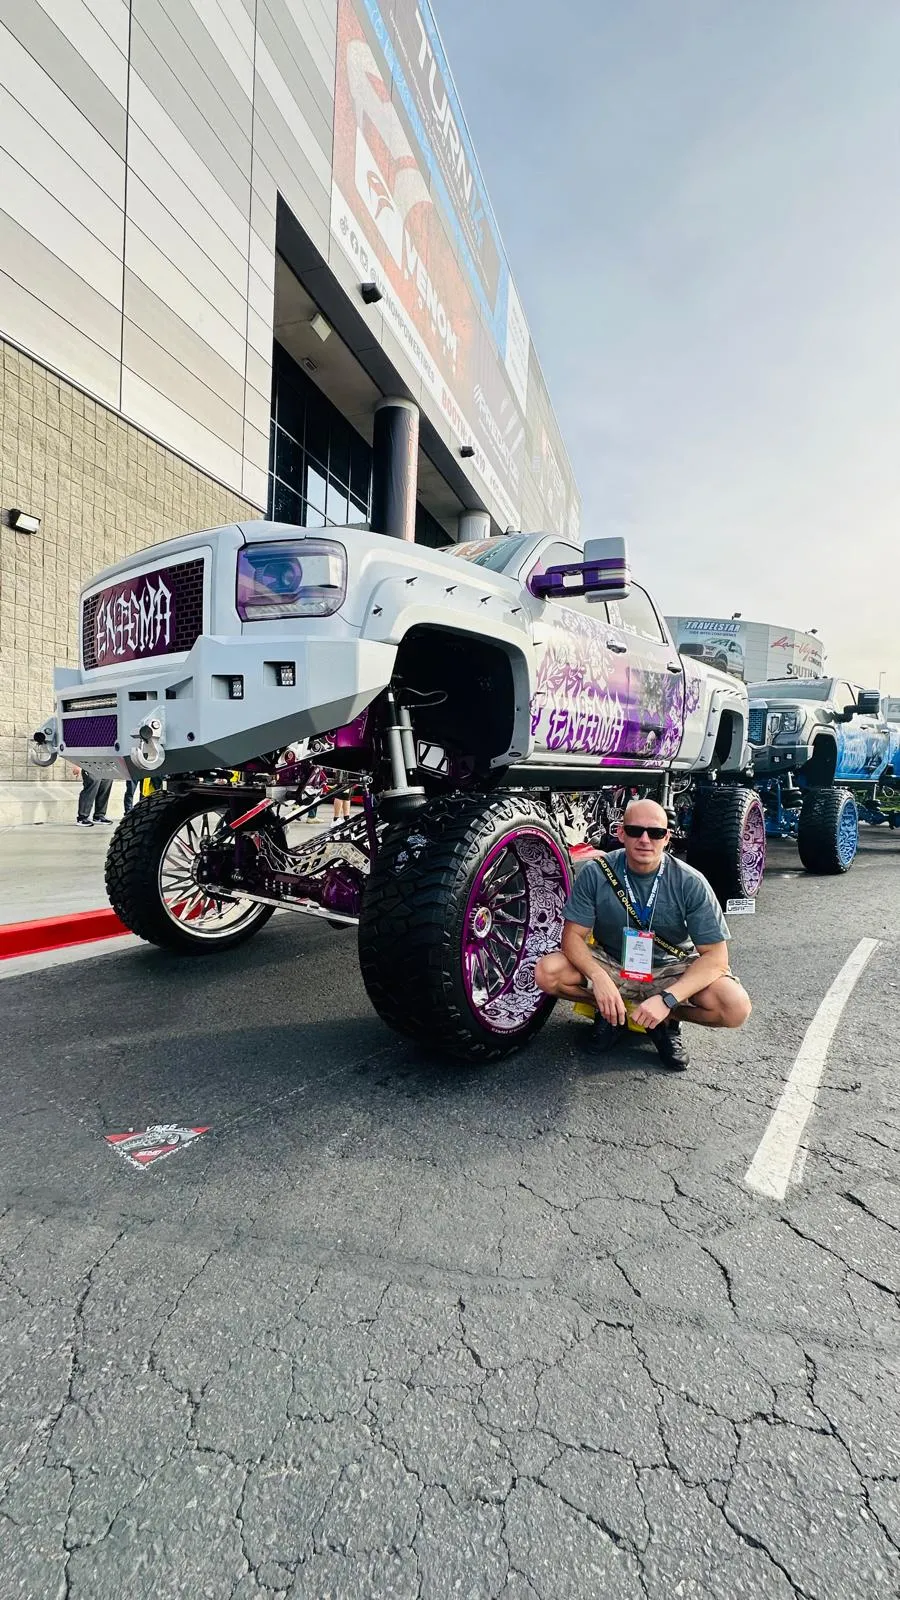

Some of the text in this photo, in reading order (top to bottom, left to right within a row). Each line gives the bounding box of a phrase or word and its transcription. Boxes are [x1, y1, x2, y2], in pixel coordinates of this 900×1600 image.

[404, 229, 457, 362] VENOM
[96, 576, 172, 660] ENIGMA
[685, 621, 742, 632] TRAVELSTAR
[605, 868, 618, 886] FILM
[621, 897, 636, 917] QUAD
